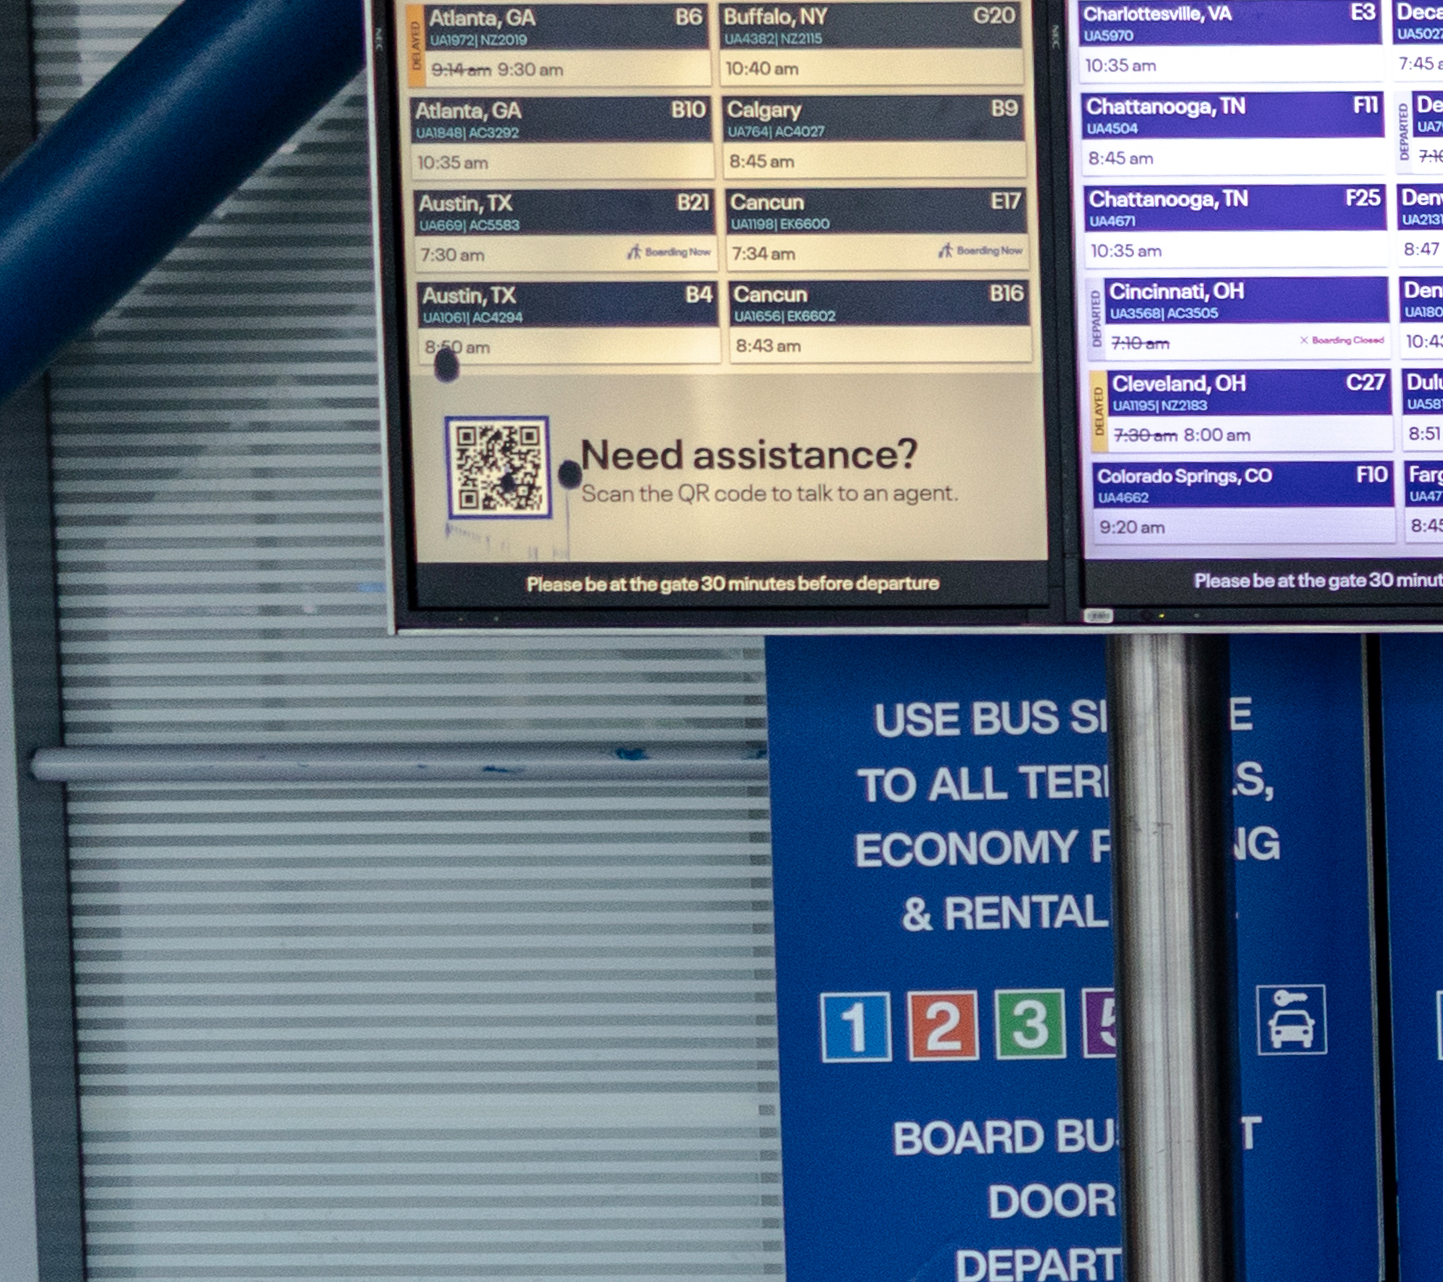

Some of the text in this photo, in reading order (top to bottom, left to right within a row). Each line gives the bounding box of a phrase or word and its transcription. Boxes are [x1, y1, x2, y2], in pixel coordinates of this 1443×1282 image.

[582, 438, 917, 469] Need assistance?
[582, 483, 958, 506] Scan the QR code to talk to an agent.
[877, 701, 1058, 736] USE BUS
[857, 831, 1077, 866] ECONOMY
